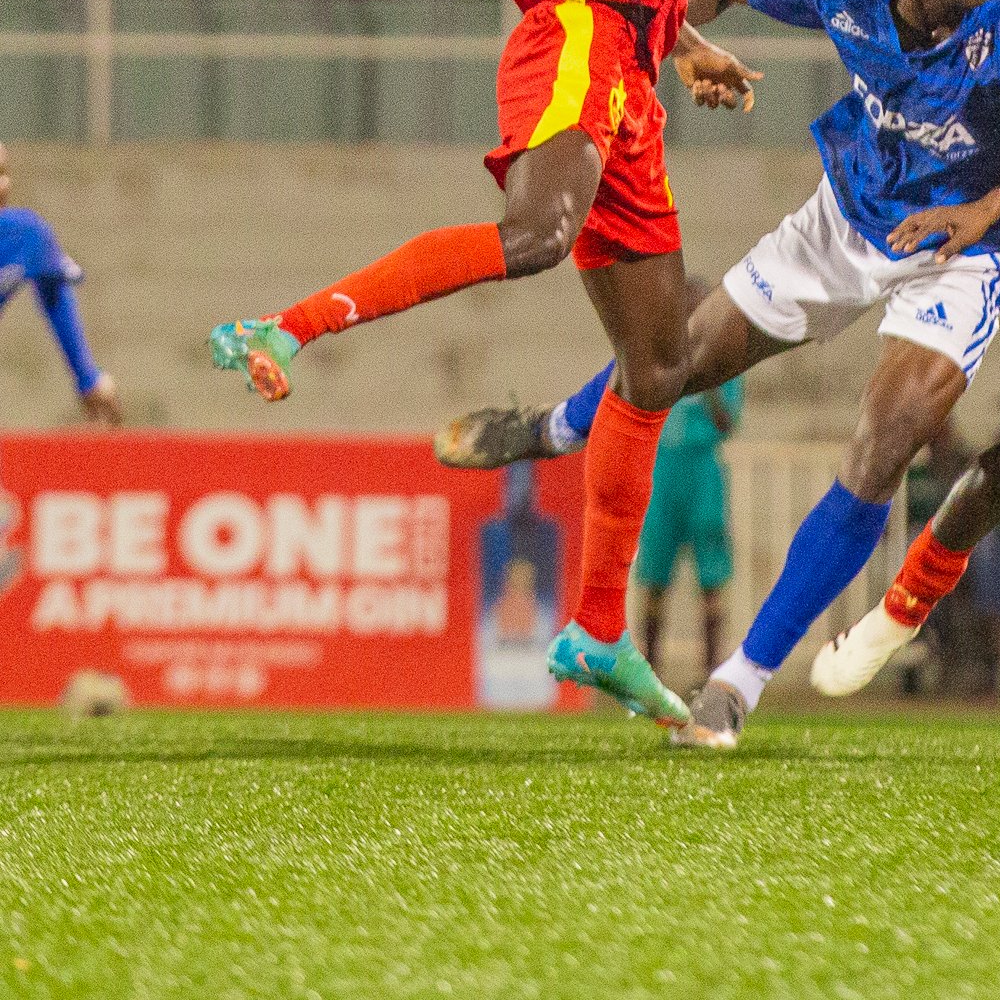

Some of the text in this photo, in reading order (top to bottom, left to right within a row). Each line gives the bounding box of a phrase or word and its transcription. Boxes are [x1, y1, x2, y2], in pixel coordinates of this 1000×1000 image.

[35, 492, 169, 574] BE
[180, 492, 409, 576] ONE
[33, 582, 79, 631] A
[83, 580, 340, 632] PREMIUM
